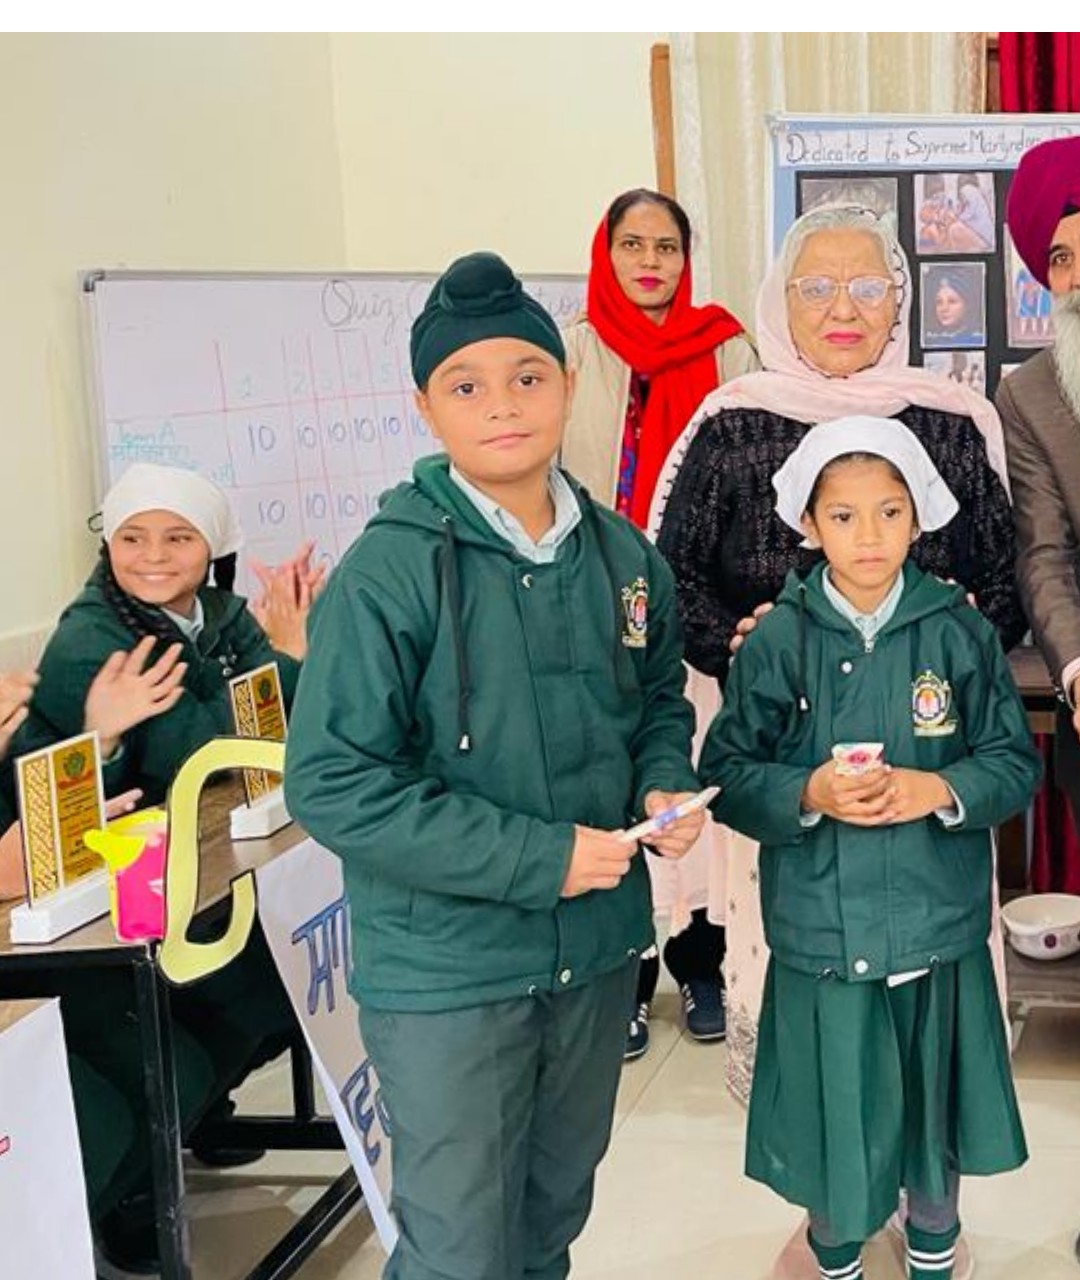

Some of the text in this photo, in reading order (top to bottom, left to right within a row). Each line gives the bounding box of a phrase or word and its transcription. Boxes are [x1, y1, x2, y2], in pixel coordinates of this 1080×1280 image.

[786, 132, 868, 165] Dedicated
[885, 132, 901, 161] to
[248, 424, 276, 453] 10
[297, 425, 318, 448] 10
[328, 421, 346, 442] 10
[354, 418, 376, 442] 10
[382, 416, 400, 437] 10
[258, 499, 286, 526] 10
[305, 493, 327, 520] 10
[337, 493, 357, 519] 10
